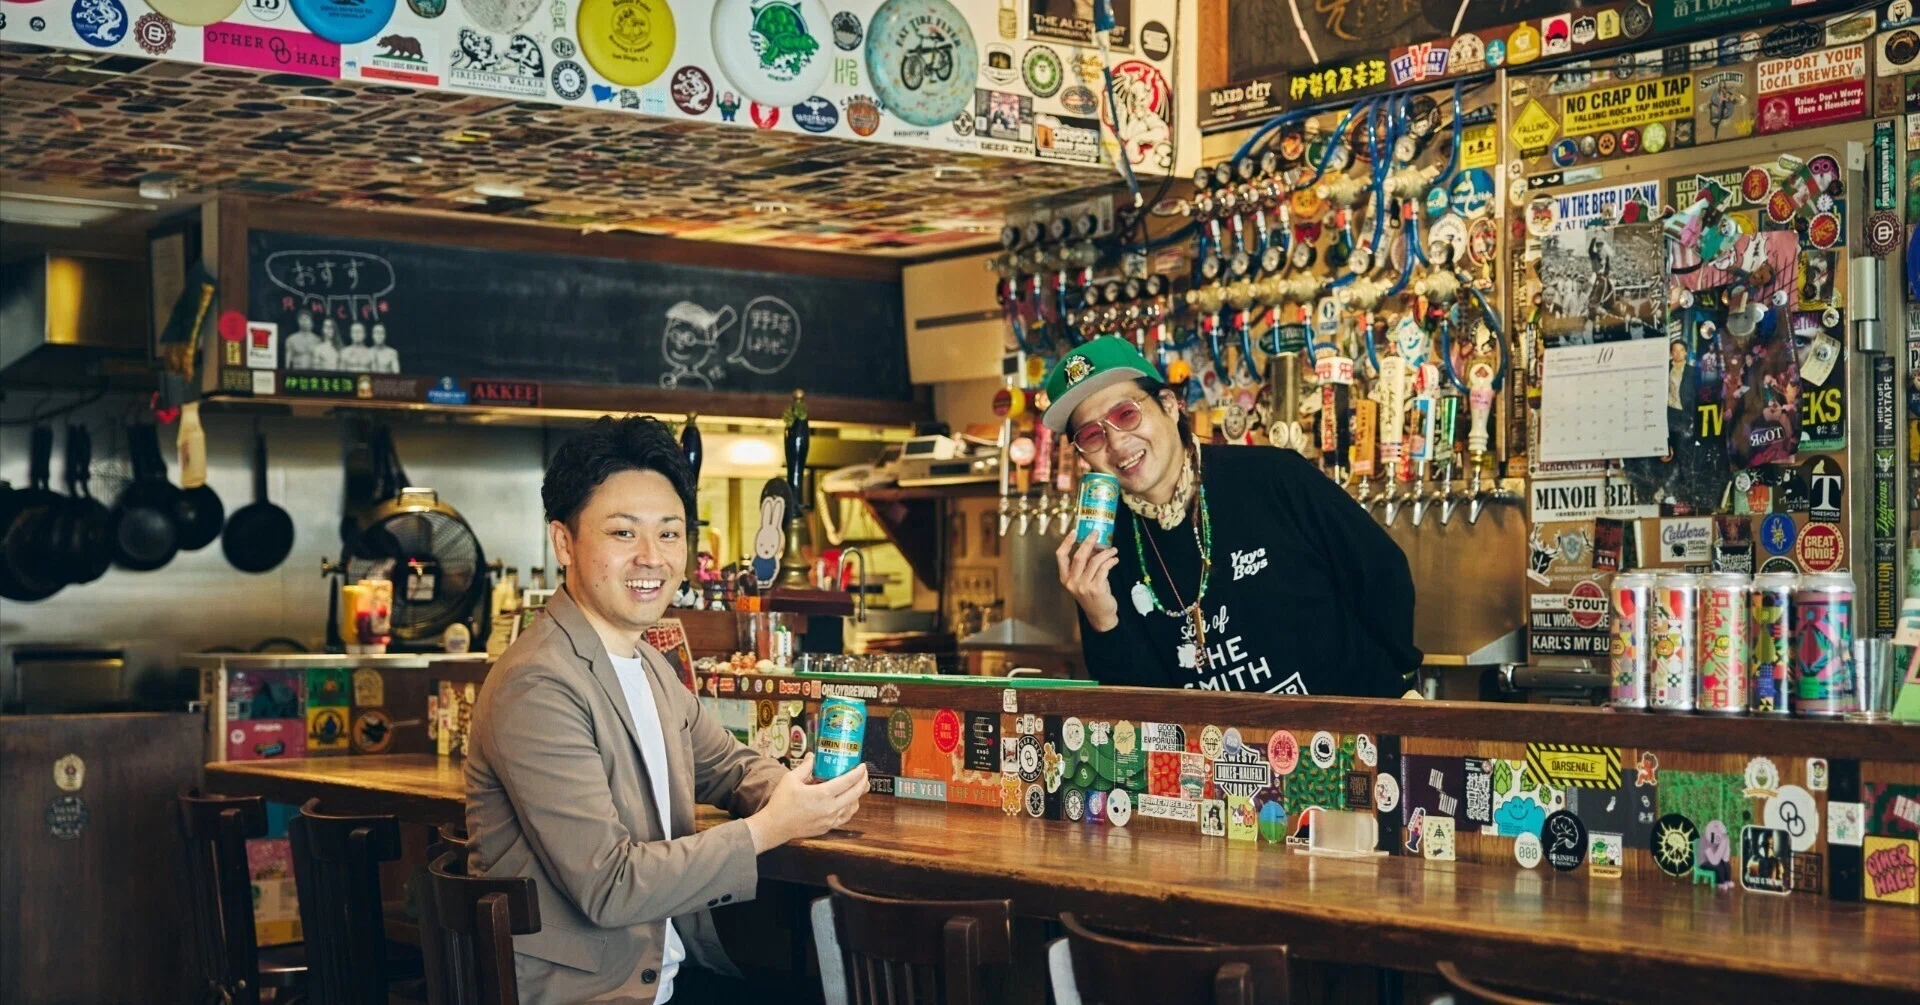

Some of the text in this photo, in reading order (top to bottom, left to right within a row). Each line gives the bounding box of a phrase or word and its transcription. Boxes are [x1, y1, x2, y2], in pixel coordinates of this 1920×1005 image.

[1034, 14, 1057, 27] THE
[909, 15, 932, 32] TIRE
[935, 18, 961, 49] FLYER
[207, 31, 340, 68] OTHER HALF
[1760, 46, 1863, 78] SUPPORT YOUR
[450, 68, 544, 88] FIRESTONE WALKER
[1760, 63, 1855, 92] LOCAL BREWERY
[1566, 77, 1690, 114] NO CRAP ON TAP
[1819, 91, 1839, 102] Don't
[1574, 98, 1681, 123] FALLING ROCK TAP HOUSE
[1798, 98, 1861, 115] Have a Homebrew
[1518, 121, 1549, 144] FALLING ROCK
[1876, 121, 1891, 130] STONE
[1676, 179, 1697, 193] KEEP
[1572, 194, 1589, 216] THE
[292, 259, 364, 290] おすす
[1597, 347, 1614, 364] 10
[474, 382, 533, 399] AKKEE
[1884, 376, 1893, 430] MIXTAPE
[1536, 486, 1597, 511] MINOH
[1876, 481, 1888, 537] Delicious
[1662, 522, 1710, 545] Caldera
[1804, 536, 1835, 548] GREAT
[1231, 548, 1266, 567] Yuya
[1597, 556, 1615, 566] AAA
[1804, 548, 1835, 560] DIVIDE
[1233, 559, 1268, 580] Boys
[1568, 598, 1607, 611] STOUT
[1212, 605, 1230, 634] of
[1532, 613, 1552, 627] WILL
[1532, 635, 1610, 651] KARL'S MY BU
[895, 721, 906, 730] THE
[941, 723, 951, 731] THE
[894, 730, 906, 739] VEIL
[821, 740, 840, 748] KIRIN
[1228, 753, 1253, 763] WEST
[1552, 760, 1596, 773] DARSENALE
[1217, 765, 1264, 782] DUKES-HALIFAX
[898, 781, 943, 797] THE VEIL
[951, 786, 997, 802] THE VEIL
[1229, 783, 1253, 797] YORKS
[1140, 798, 1169, 806] RAMEN
[1866, 843, 1913, 877] OTHER
[1874, 862, 1917, 897] HALF
